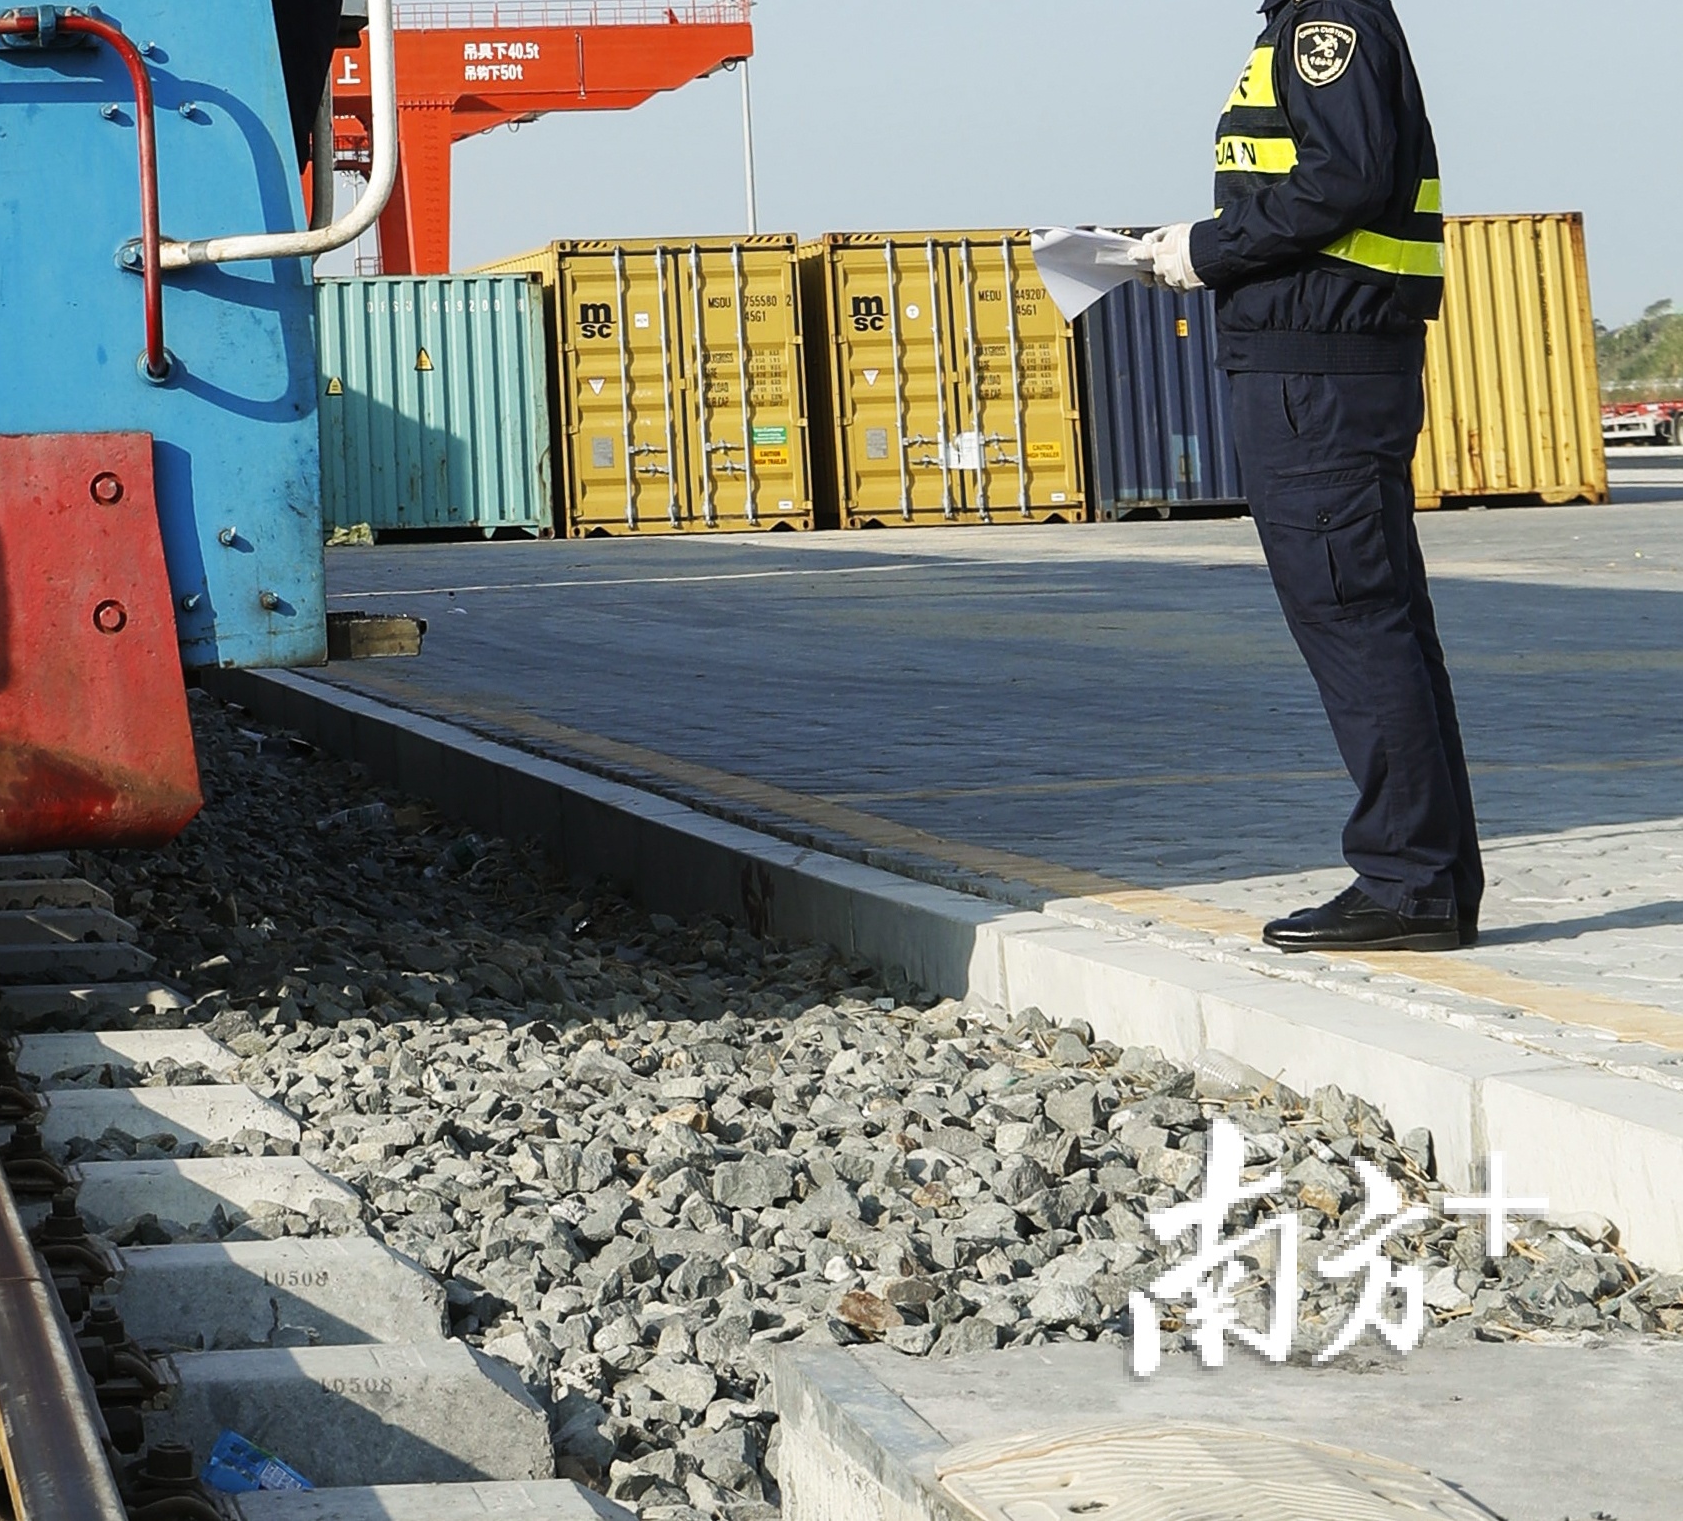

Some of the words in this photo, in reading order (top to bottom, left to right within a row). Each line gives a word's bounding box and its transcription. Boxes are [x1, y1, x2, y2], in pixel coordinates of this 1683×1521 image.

[336, 55, 361, 84] 上
[785, 294, 793, 307] 2
[744, 310, 767, 322] 45G1
[1015, 304, 1037, 316] 45G1
[263, 1269, 329, 1287] 10508
[320, 1376, 393, 1394] 10508
